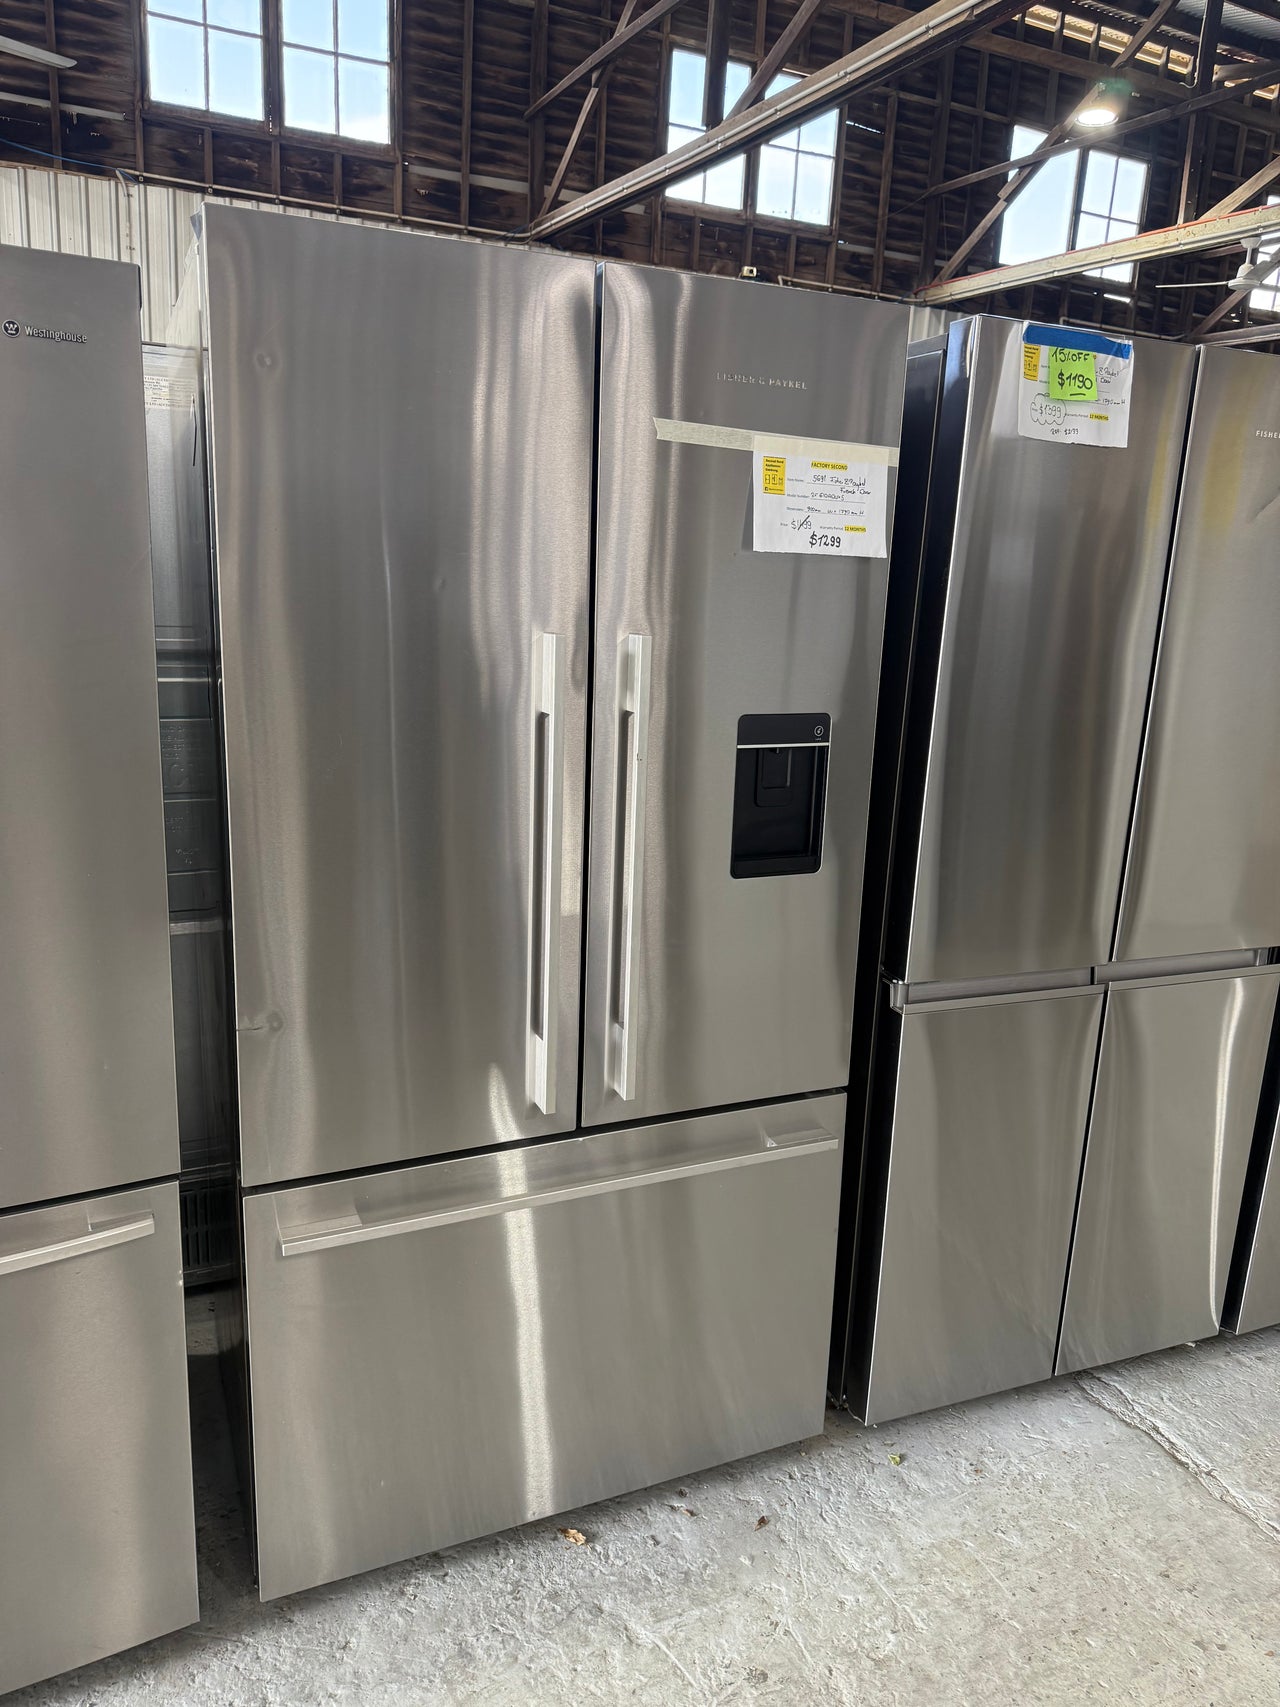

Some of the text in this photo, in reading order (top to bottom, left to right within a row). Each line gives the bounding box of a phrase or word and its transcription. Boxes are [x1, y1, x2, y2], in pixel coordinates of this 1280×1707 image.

[24, 325, 87, 343] Westinghouse
[768, 378, 807, 390] PAYKEL
[1057, 368, 1093, 390] $1190
[811, 462, 849, 471] FACTORY SECOND
[809, 530, 841, 549] $1299
